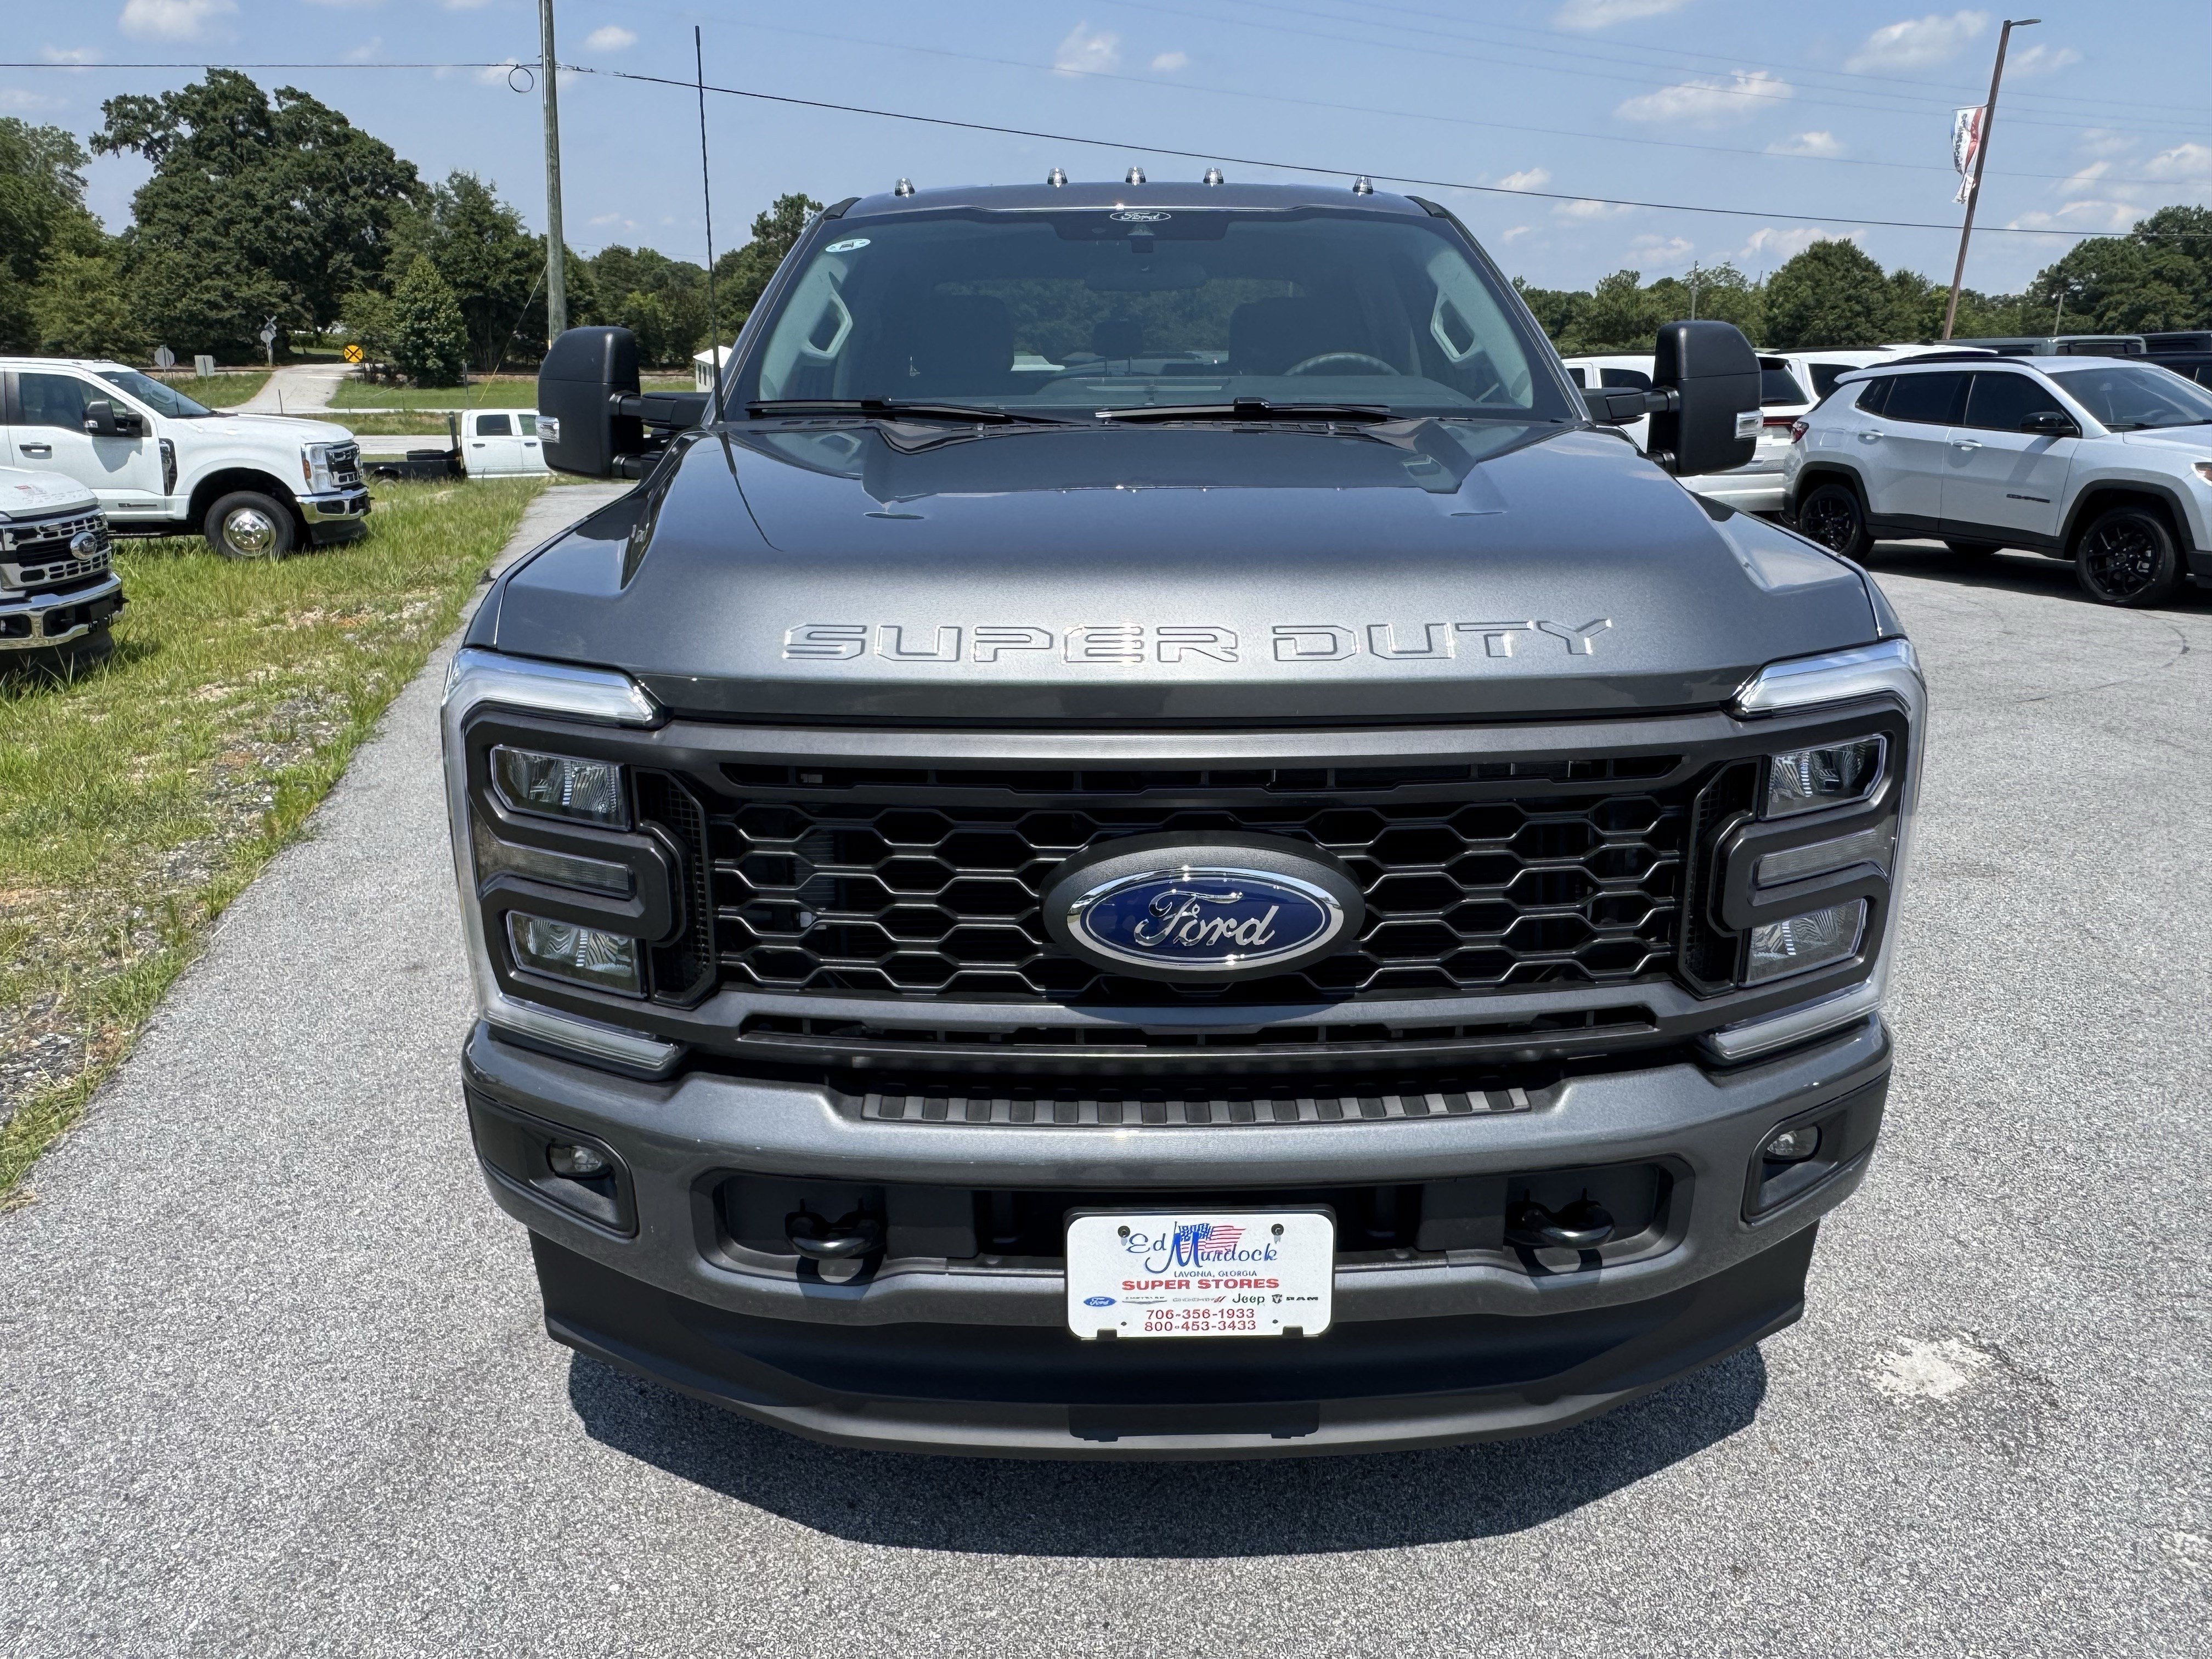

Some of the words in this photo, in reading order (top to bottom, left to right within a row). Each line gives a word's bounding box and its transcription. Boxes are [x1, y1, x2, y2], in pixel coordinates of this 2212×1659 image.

[783, 624, 1240, 663] SUPER
[1271, 618, 1613, 662] DUTY
[1134, 889, 1279, 947] Ford
[1126, 1233, 1167, 1254] Ed
[1145, 1231, 1278, 1274] Murdock
[1122, 1280, 1190, 1290] SUPER
[1198, 1278, 1279, 1289] STORES
[1232, 1293, 1265, 1305] Jeep
[1147, 1308, 1255, 1319] 706-356-1933
[1145, 1321, 1256, 1331] 800-453-3433
